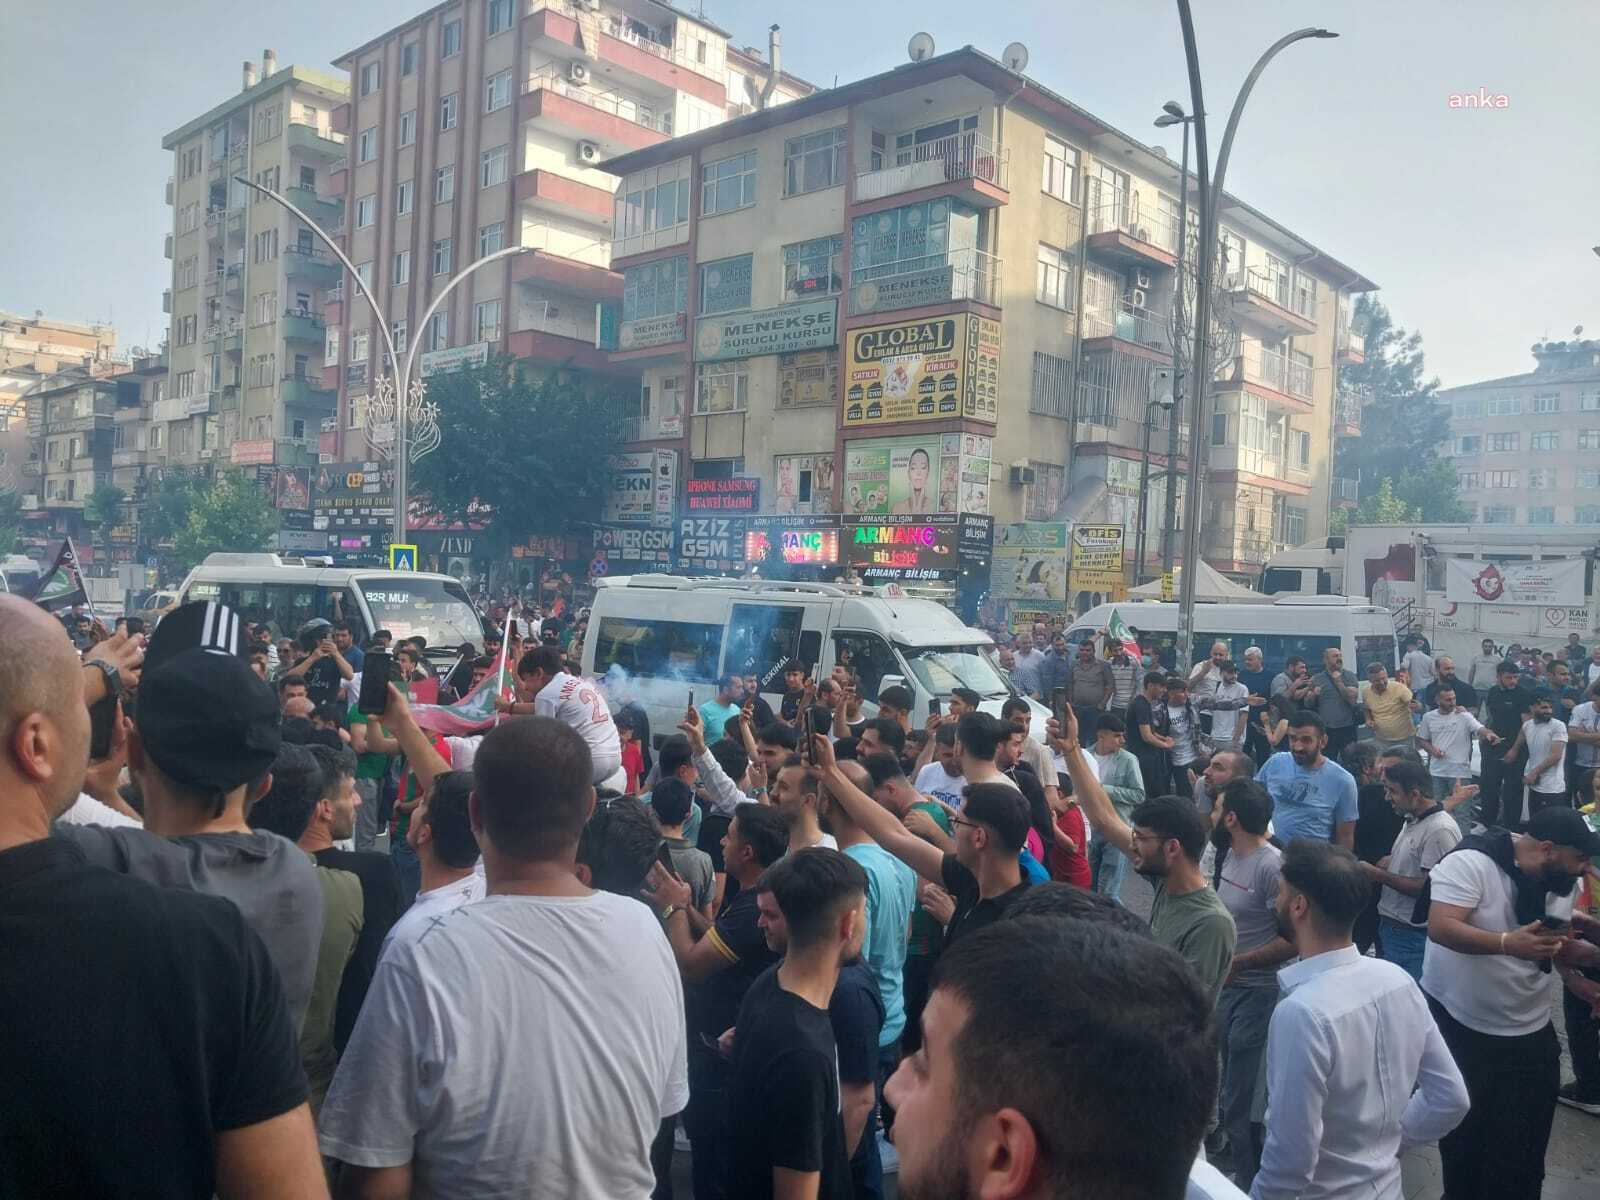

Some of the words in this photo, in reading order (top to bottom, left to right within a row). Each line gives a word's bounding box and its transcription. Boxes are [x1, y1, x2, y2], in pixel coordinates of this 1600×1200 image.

[724, 311, 832, 337] MENEKŞE
[783, 326, 832, 341] KURSU
[856, 321, 953, 360] GLOBAL
[854, 526, 936, 547] ARMANÇ
[681, 538, 729, 558] GSM
[864, 568, 901, 578] ARMANÇ
[1568, 609, 1588, 617] KAN
